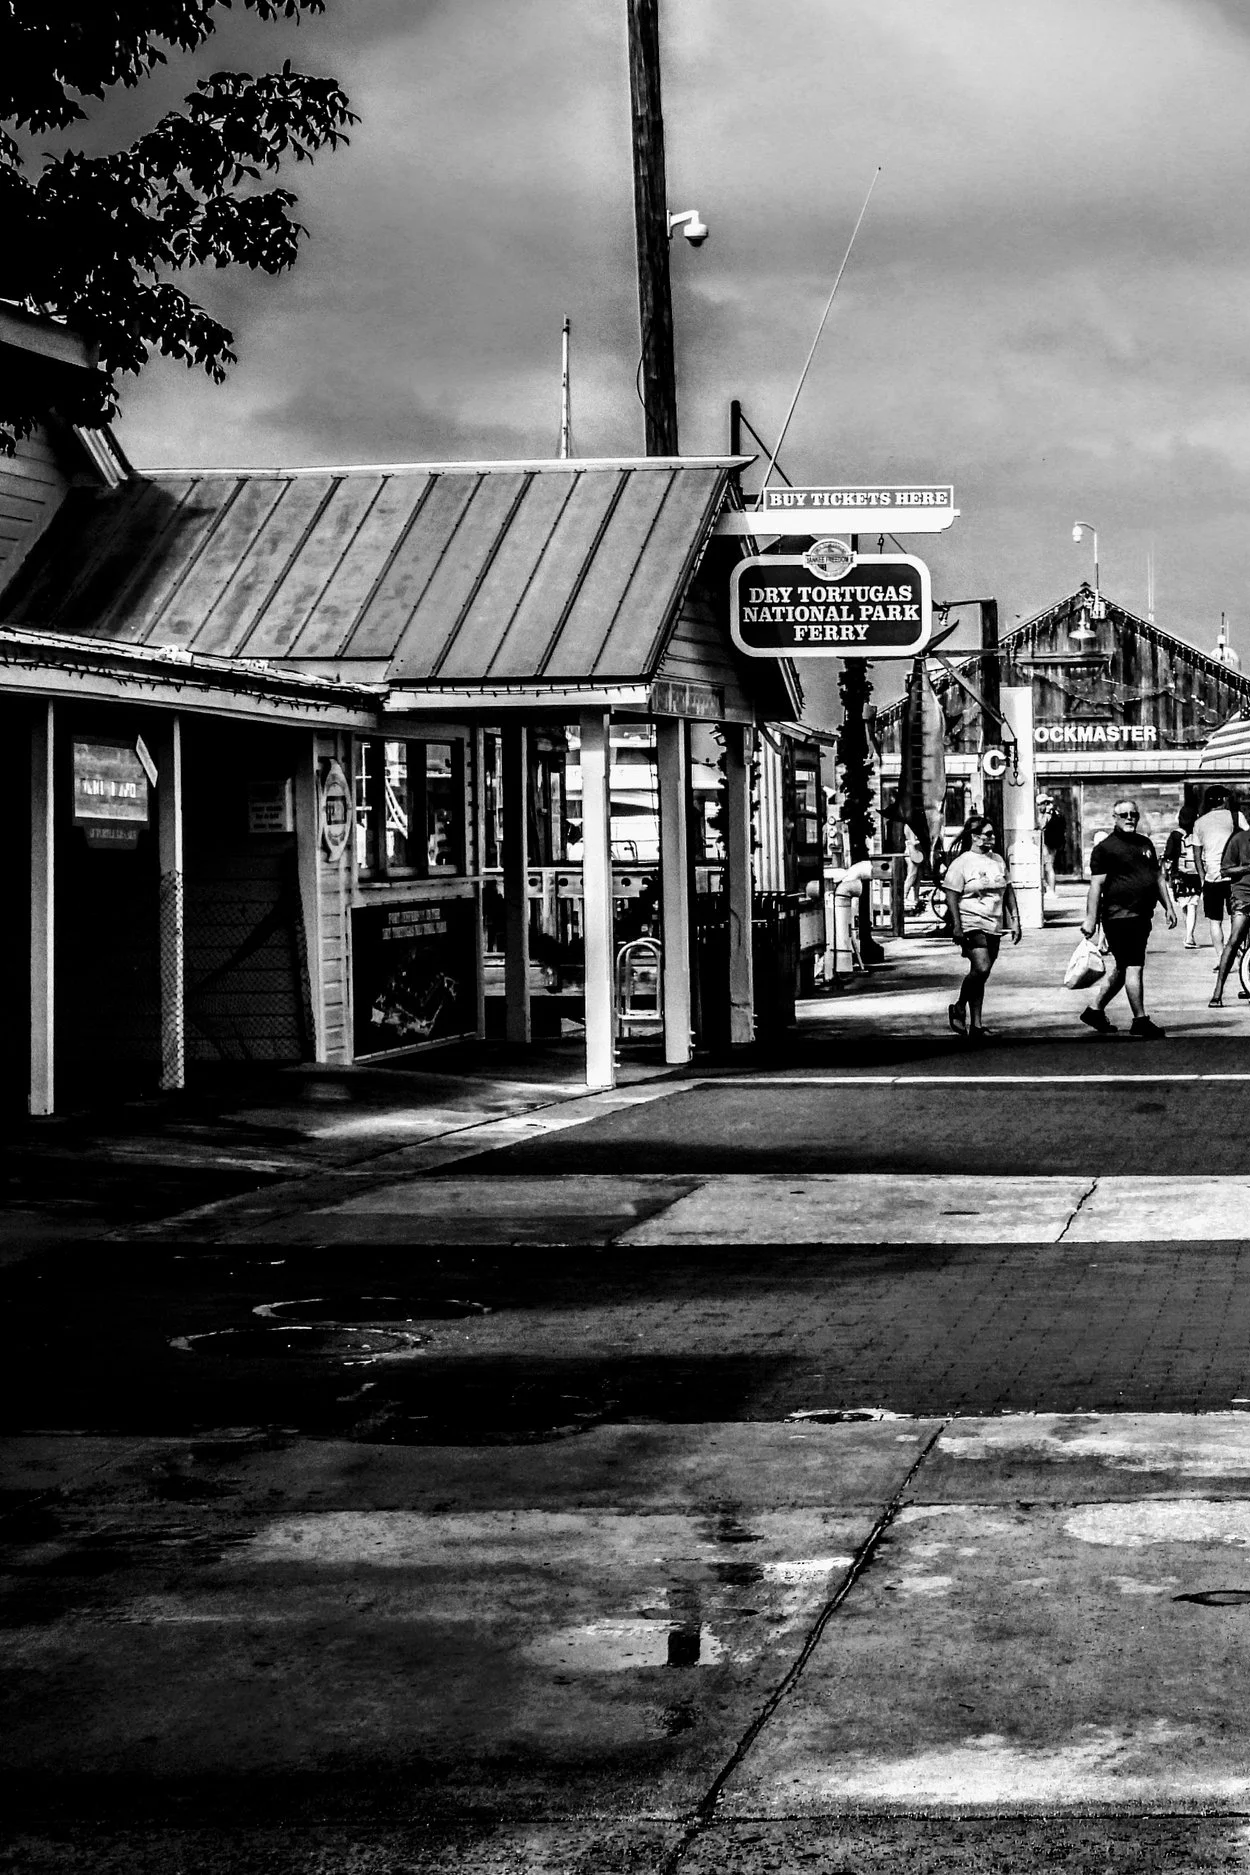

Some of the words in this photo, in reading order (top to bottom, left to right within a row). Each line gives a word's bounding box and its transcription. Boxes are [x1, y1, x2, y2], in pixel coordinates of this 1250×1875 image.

[769, 493, 807, 506] BUY
[811, 492, 891, 506] TICKETS
[895, 491, 948, 505] HERE
[749, 587, 793, 603] DRY
[798, 585, 913, 602] TORTUGAS
[743, 606, 854, 622] NATIONAL
[859, 604, 920, 621] PARK
[793, 624, 870, 641] FERRY
[1034, 725, 1157, 743] OCKMASTER
